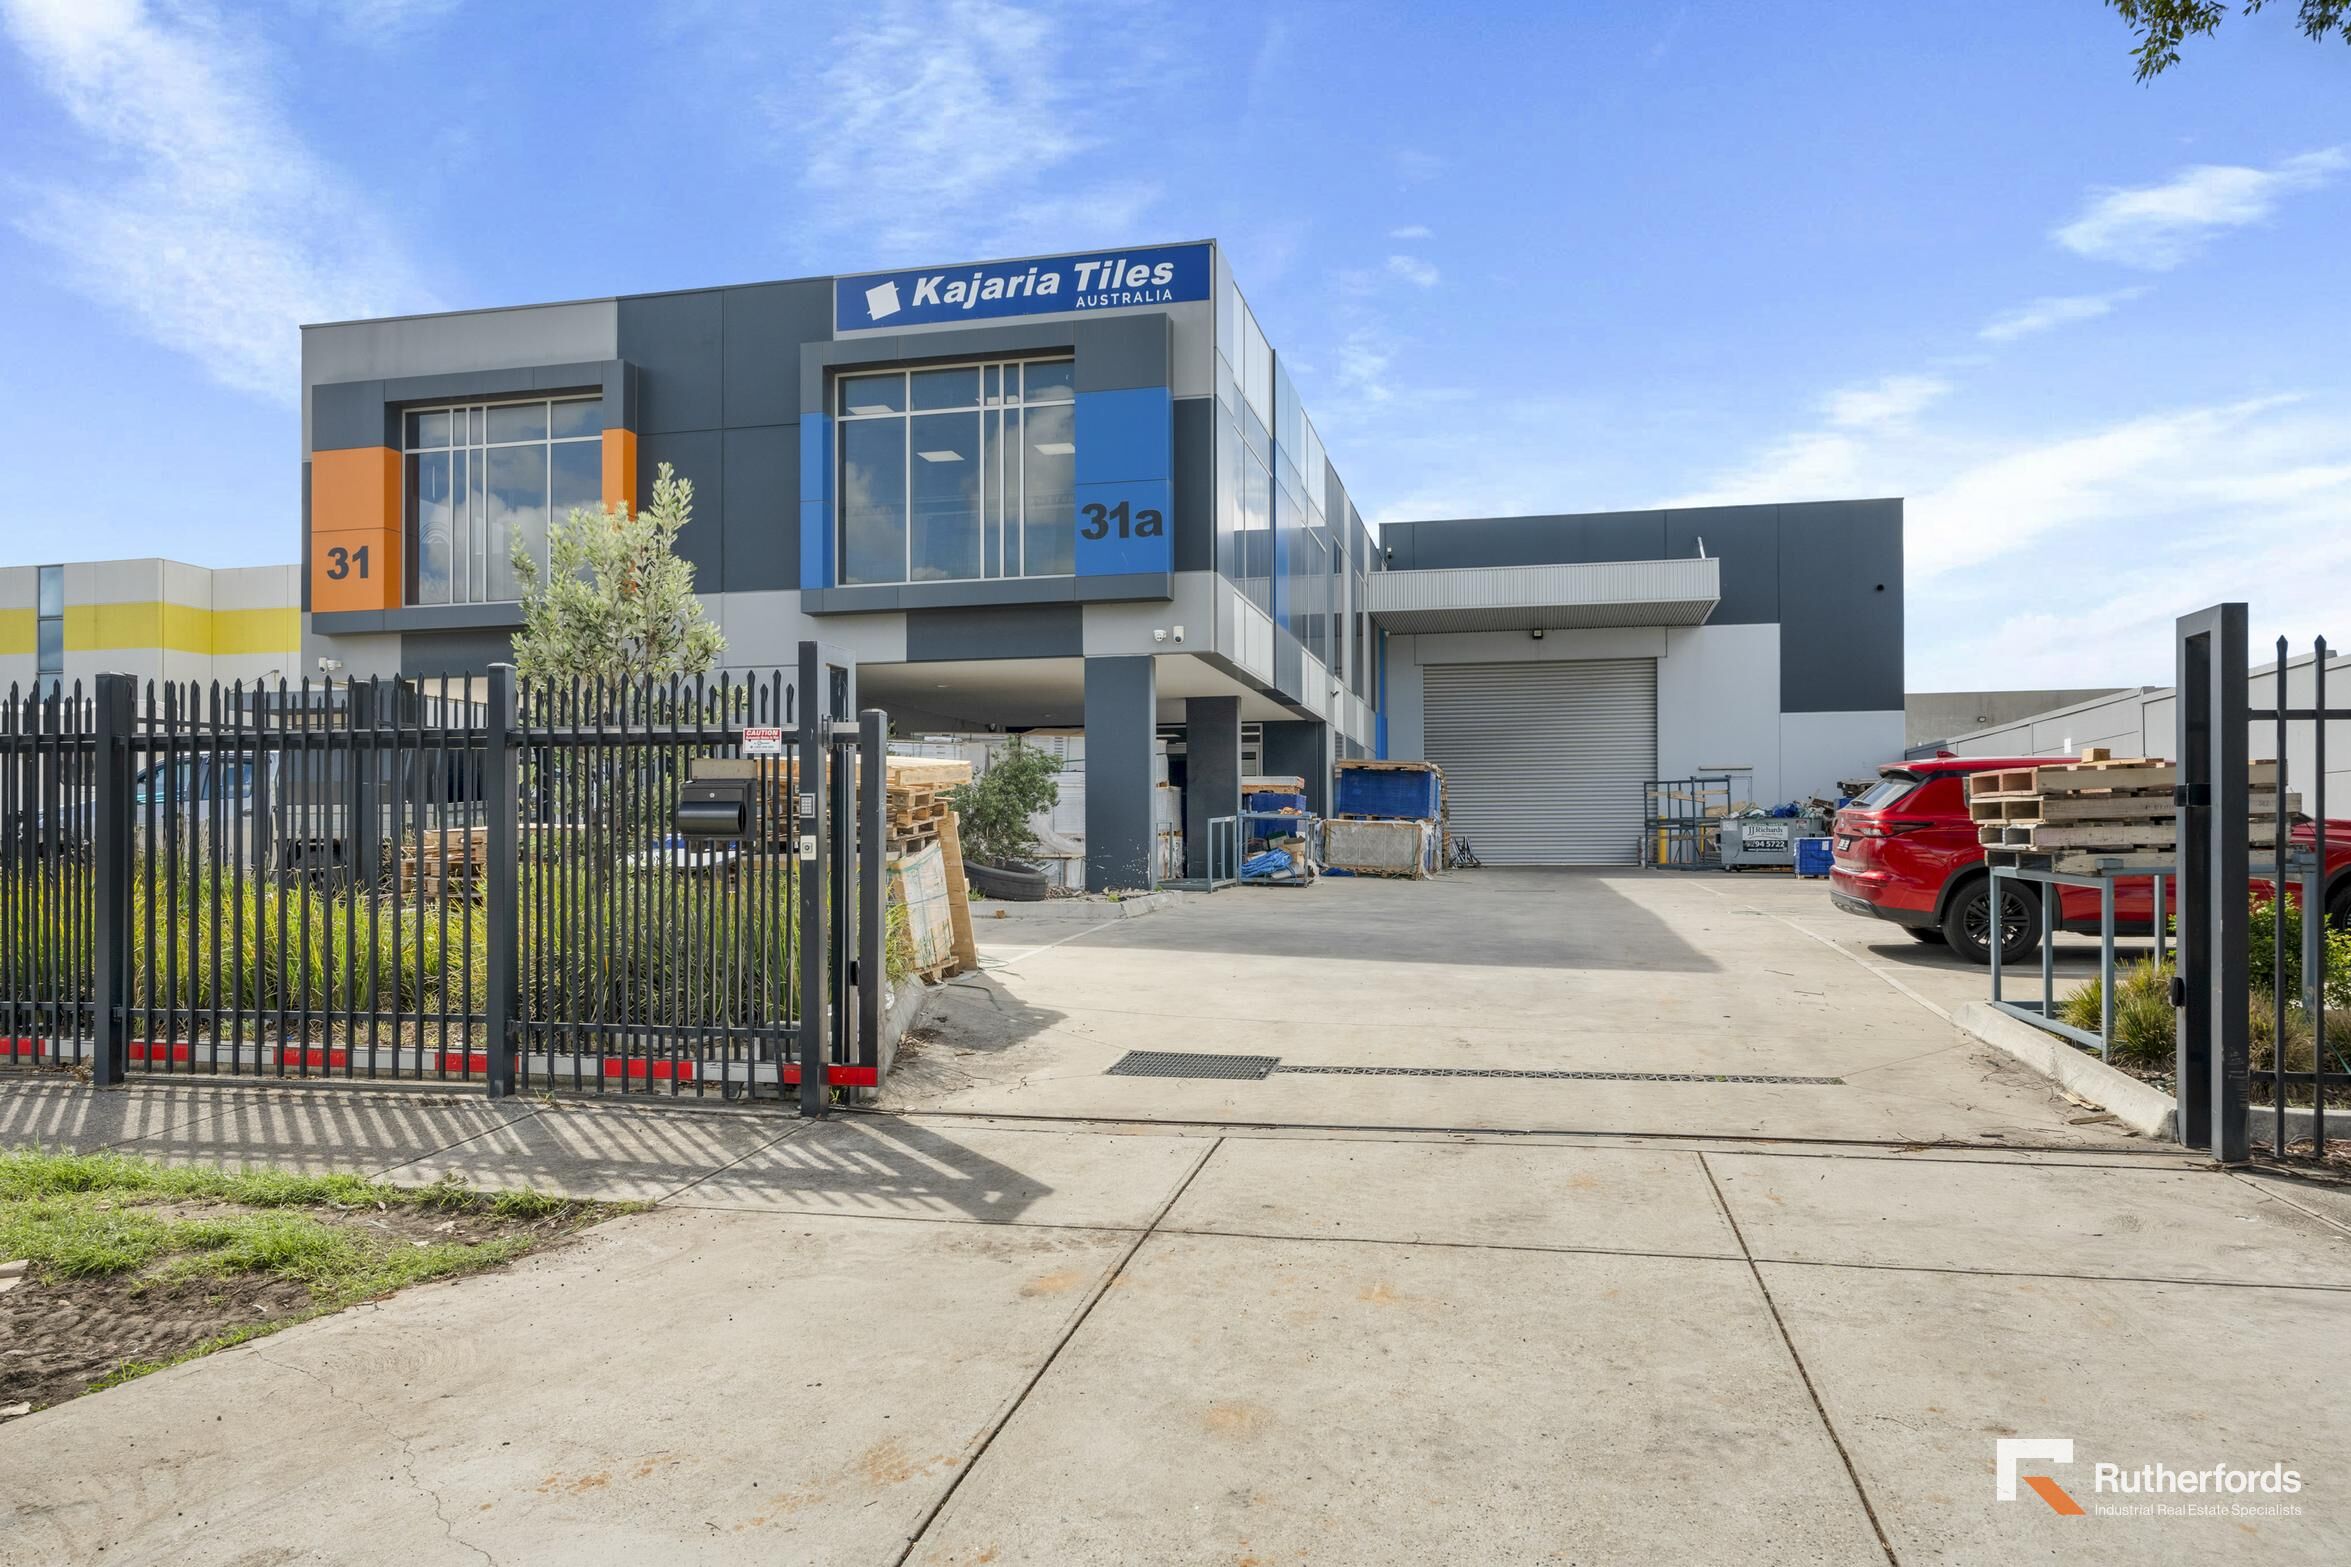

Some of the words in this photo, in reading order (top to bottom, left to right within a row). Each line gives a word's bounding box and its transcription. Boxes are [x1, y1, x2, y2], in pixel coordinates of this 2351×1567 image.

[911, 266, 1060, 310] Kajaria
[1073, 258, 1175, 292] Tiles
[1075, 288, 1173, 308] AUSTRALIA
[1080, 501, 1163, 540] 31a
[326, 545, 369, 580] 31
[1765, 840, 1785, 848] 5722
